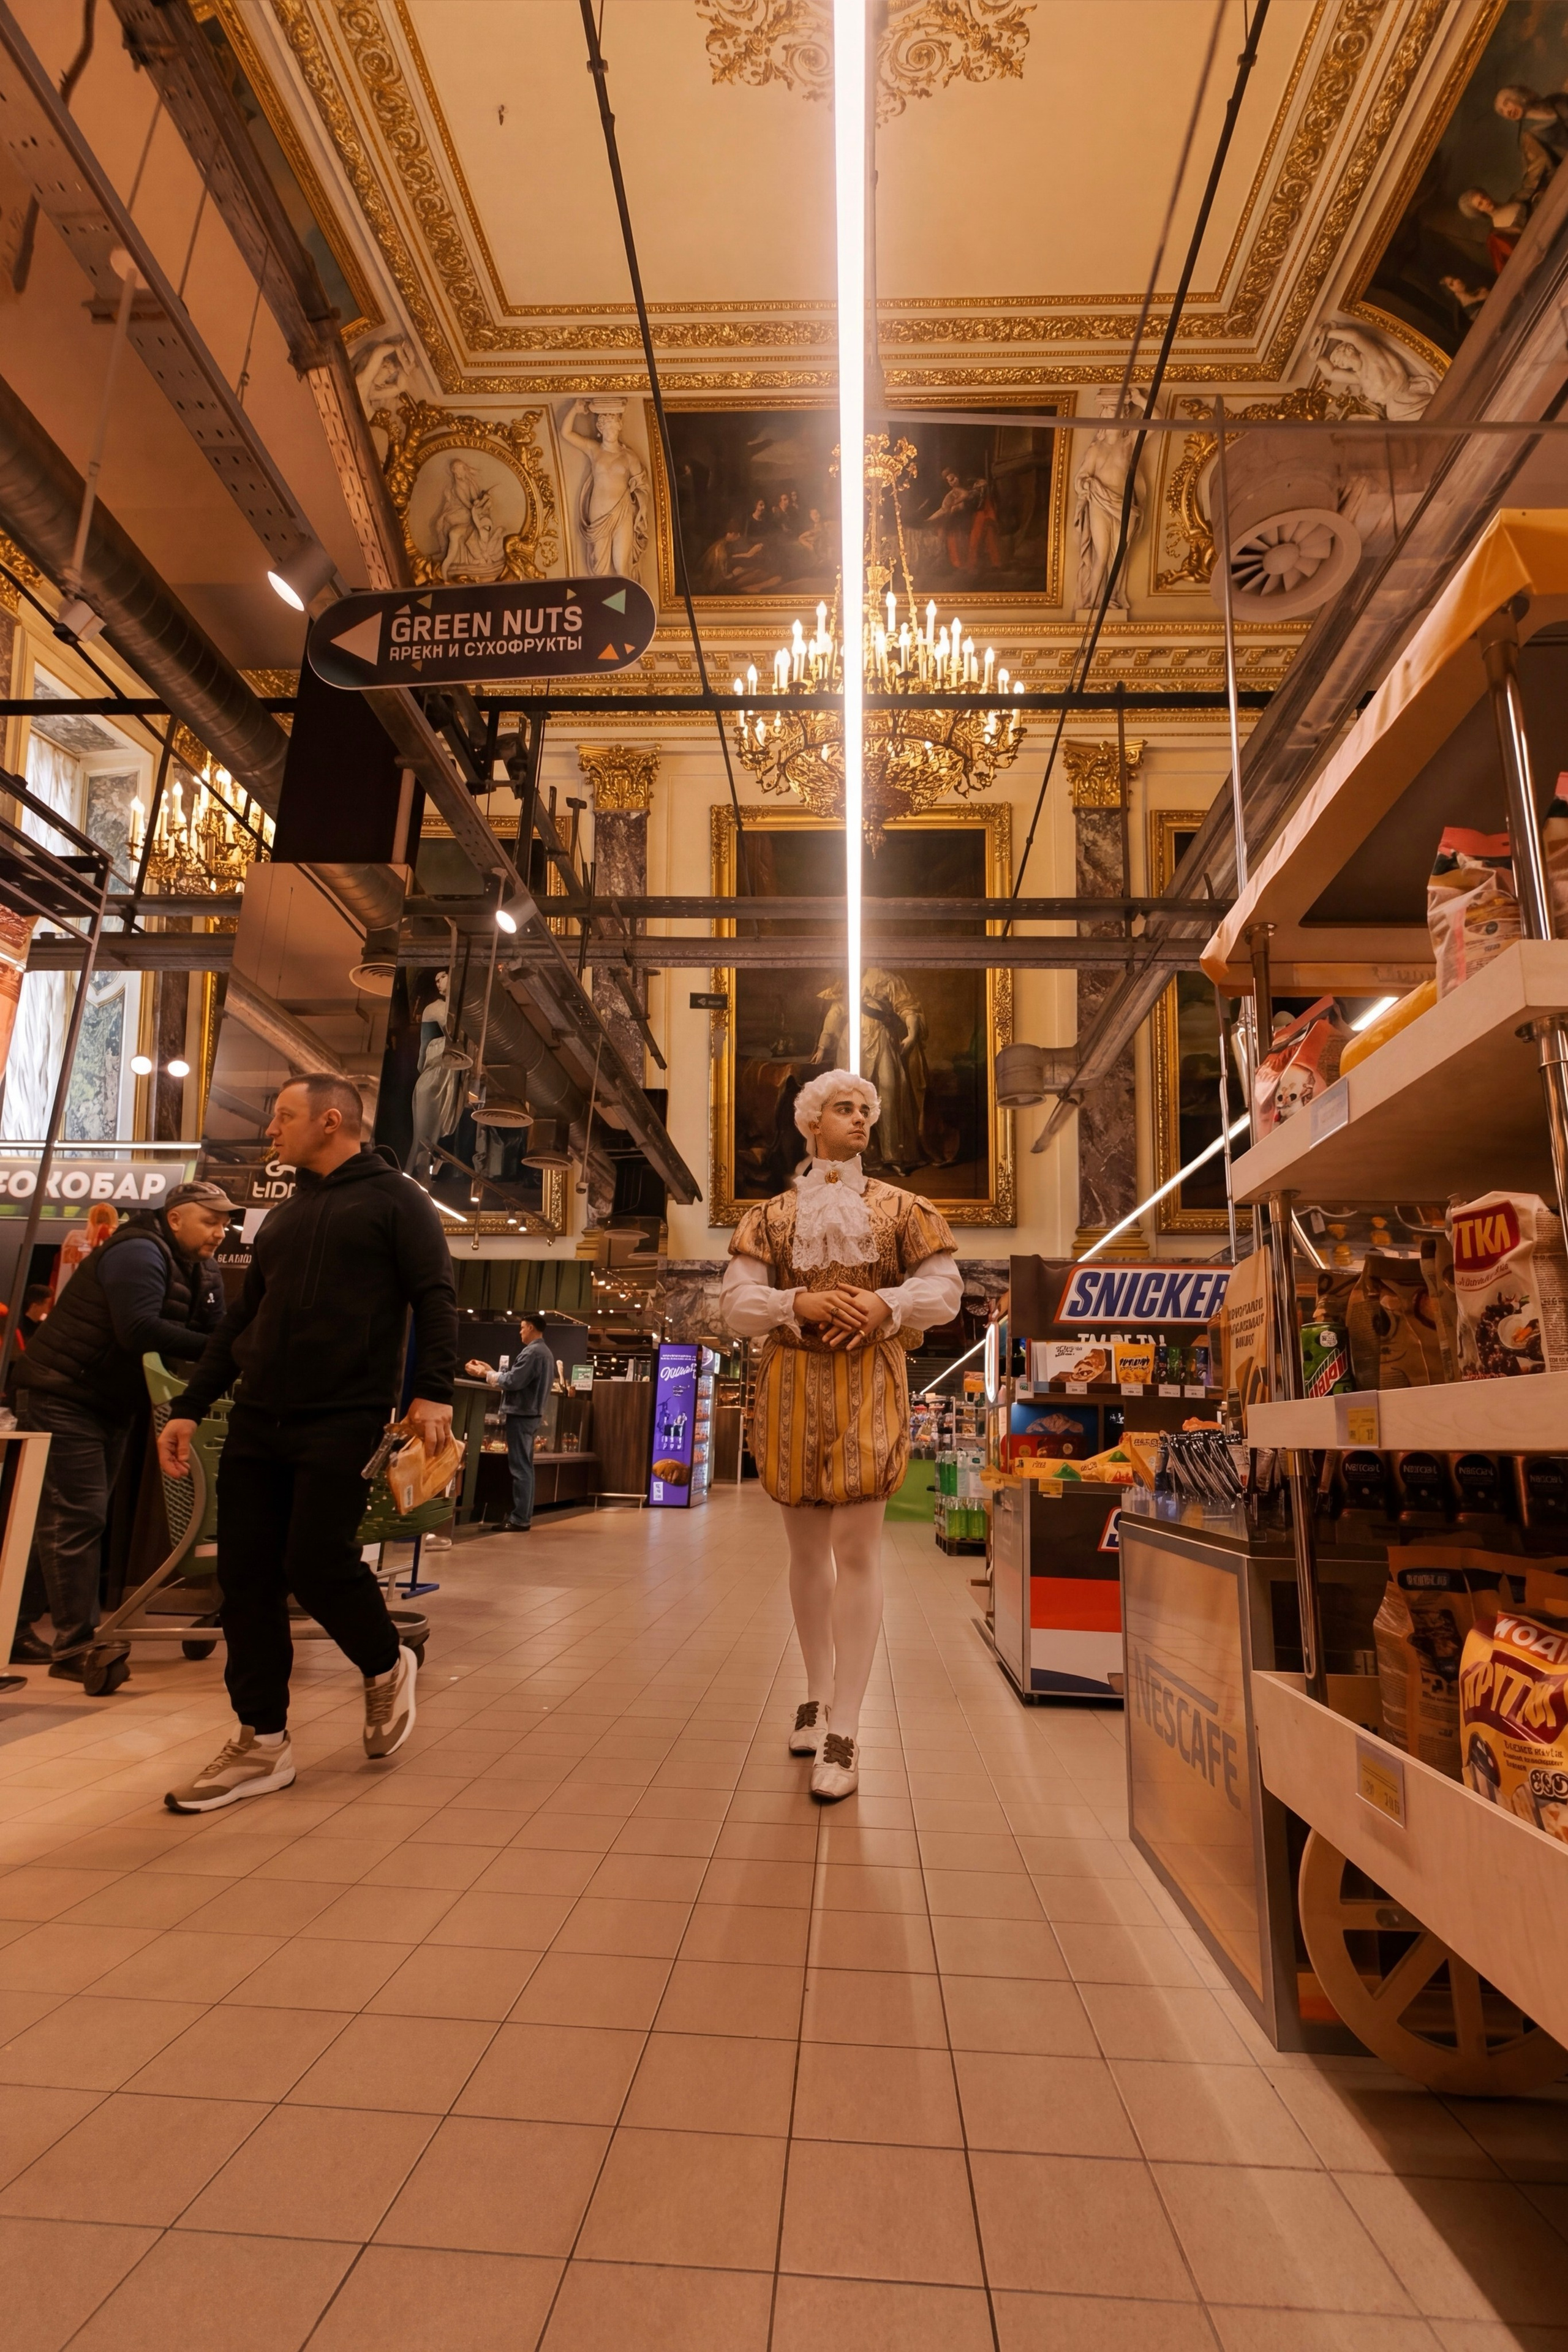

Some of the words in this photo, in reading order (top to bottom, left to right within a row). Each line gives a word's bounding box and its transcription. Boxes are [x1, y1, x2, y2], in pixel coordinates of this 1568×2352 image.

[391, 611, 492, 643] GREEN
[503, 606, 583, 636] NUTS
[449, 644, 459, 657] И
[464, 636, 582, 657] СУХОФРУКТЫ
[1066, 1272, 1231, 1318] SNICKER
